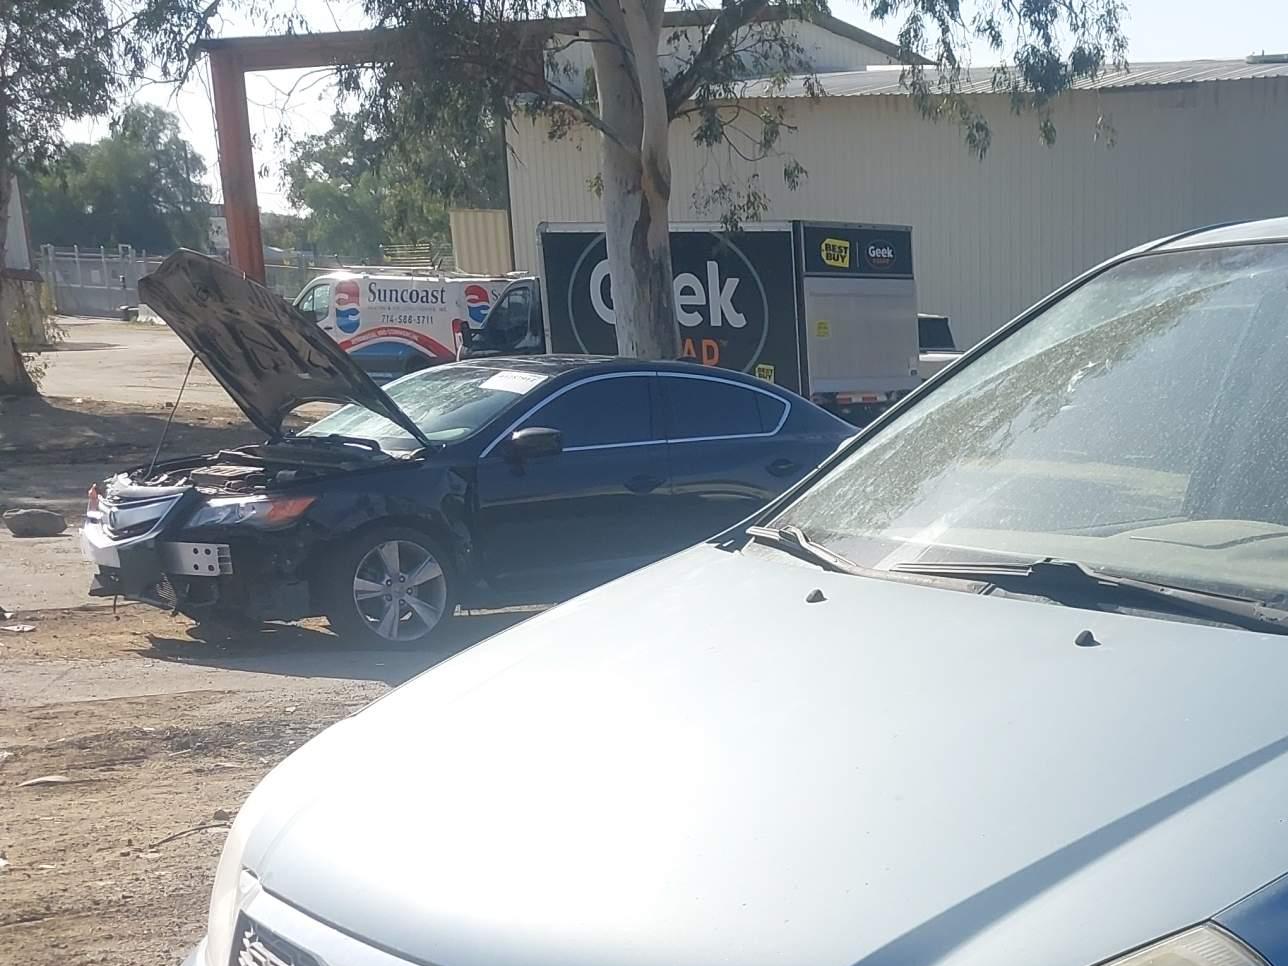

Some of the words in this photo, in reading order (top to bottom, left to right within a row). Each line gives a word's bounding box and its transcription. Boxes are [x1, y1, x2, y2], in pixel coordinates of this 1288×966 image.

[824, 243, 848, 255] BEST
[868, 245, 894, 258] Geek
[825, 252, 848, 264] BUY
[368, 282, 446, 304] Suncoast
